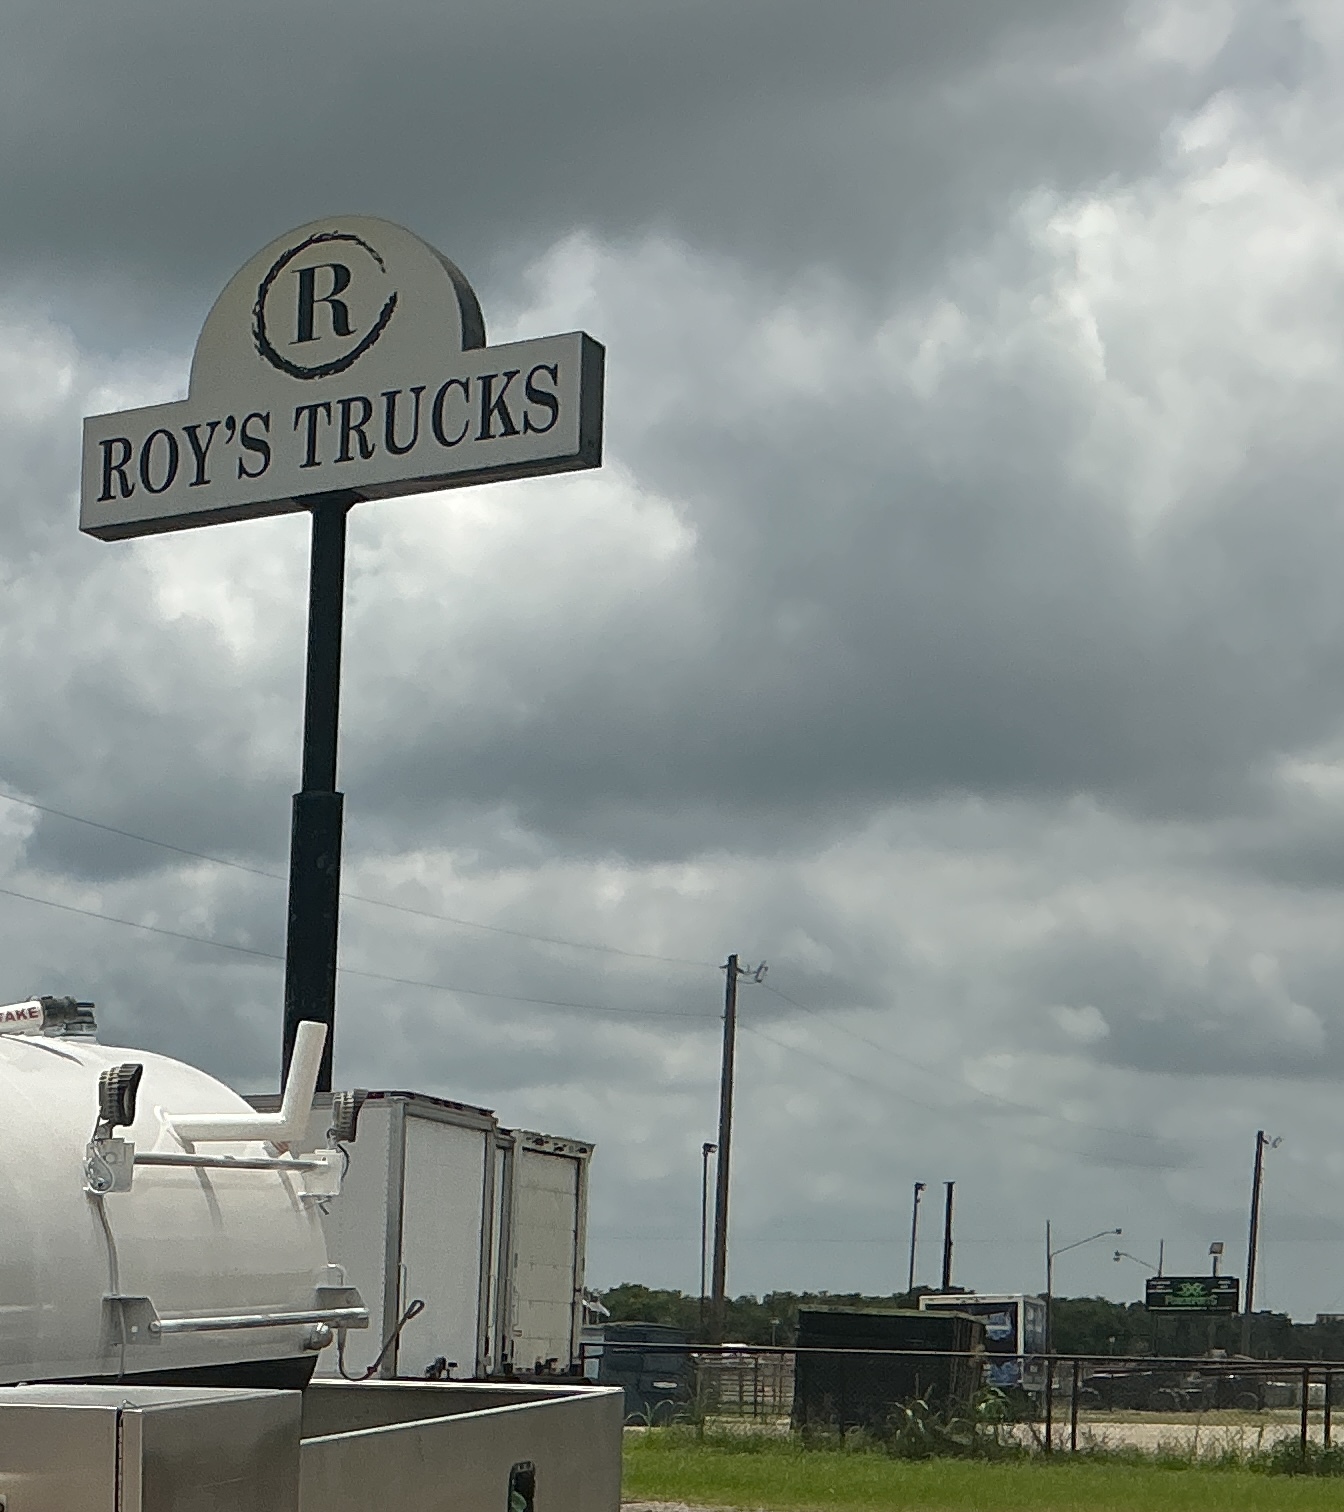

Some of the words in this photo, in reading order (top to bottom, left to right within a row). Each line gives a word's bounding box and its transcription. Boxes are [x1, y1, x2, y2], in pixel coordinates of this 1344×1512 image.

[288, 262, 358, 346] R
[96, 411, 272, 503] ROY'S
[293, 363, 561, 470] TRUCKS
